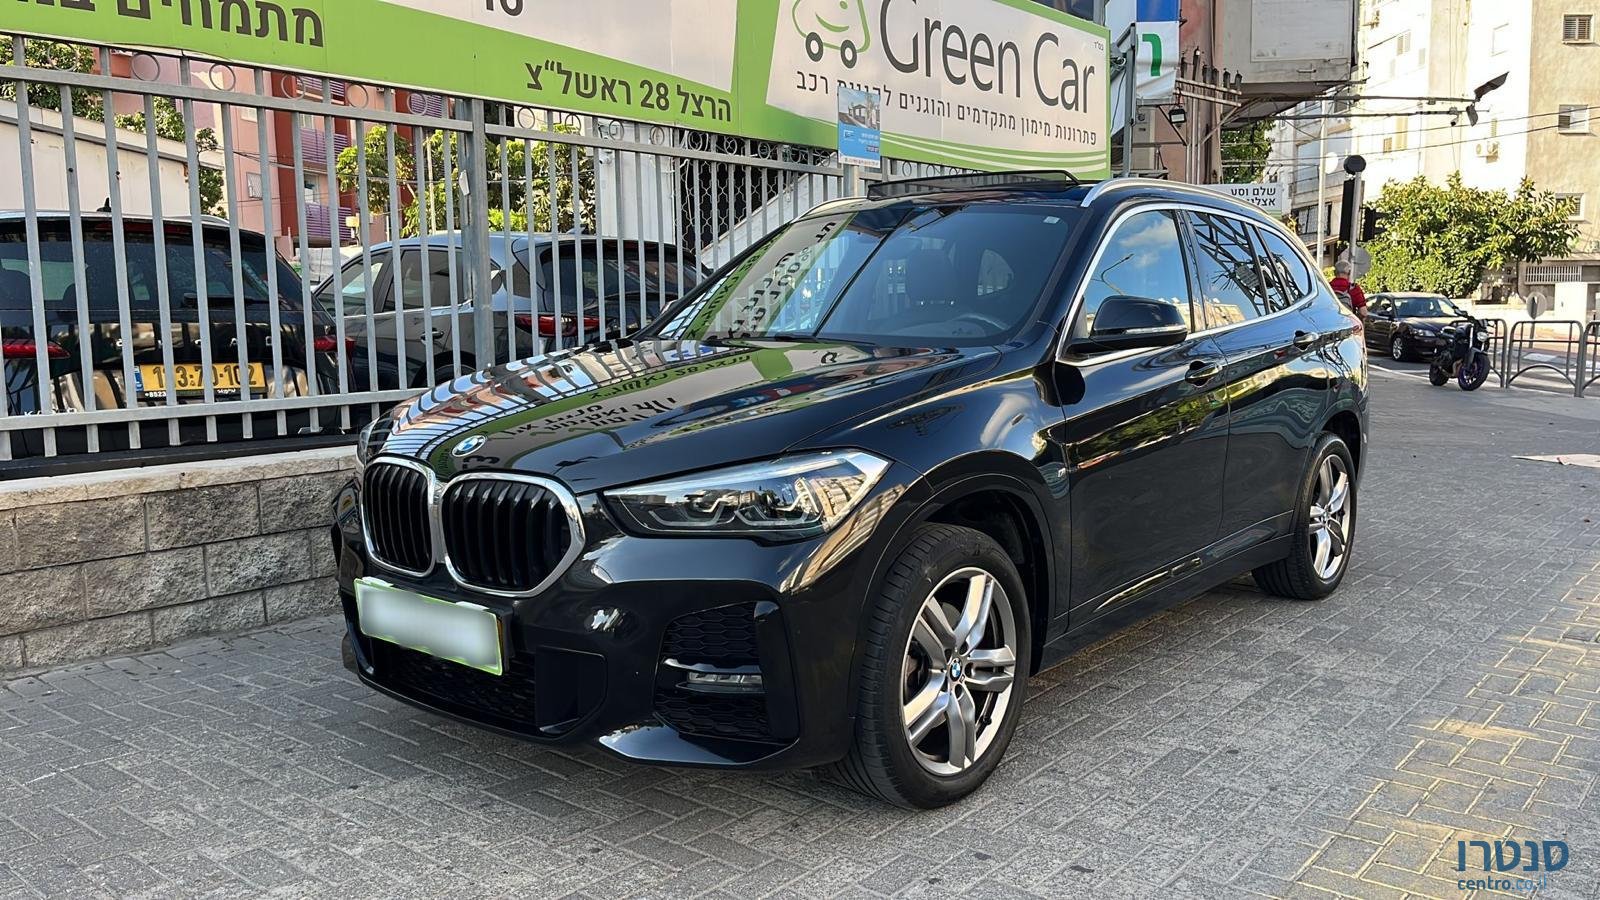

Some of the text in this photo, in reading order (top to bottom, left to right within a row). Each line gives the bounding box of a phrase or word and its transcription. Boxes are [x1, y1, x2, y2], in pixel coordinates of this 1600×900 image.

[880, 0, 1095, 114] Green Car
[639, 79, 670, 111] 28
[796, 70, 829, 95] רכב
[676, 84, 731, 122] הרצל
[900, 92, 951, 118] והוגנים
[957, 105, 1016, 131] מתקדמים
[1021, 117, 1051, 137] מימון
[1055, 124, 1097, 146] פתרונות
[1231, 186, 1276, 197] שלם וסע
